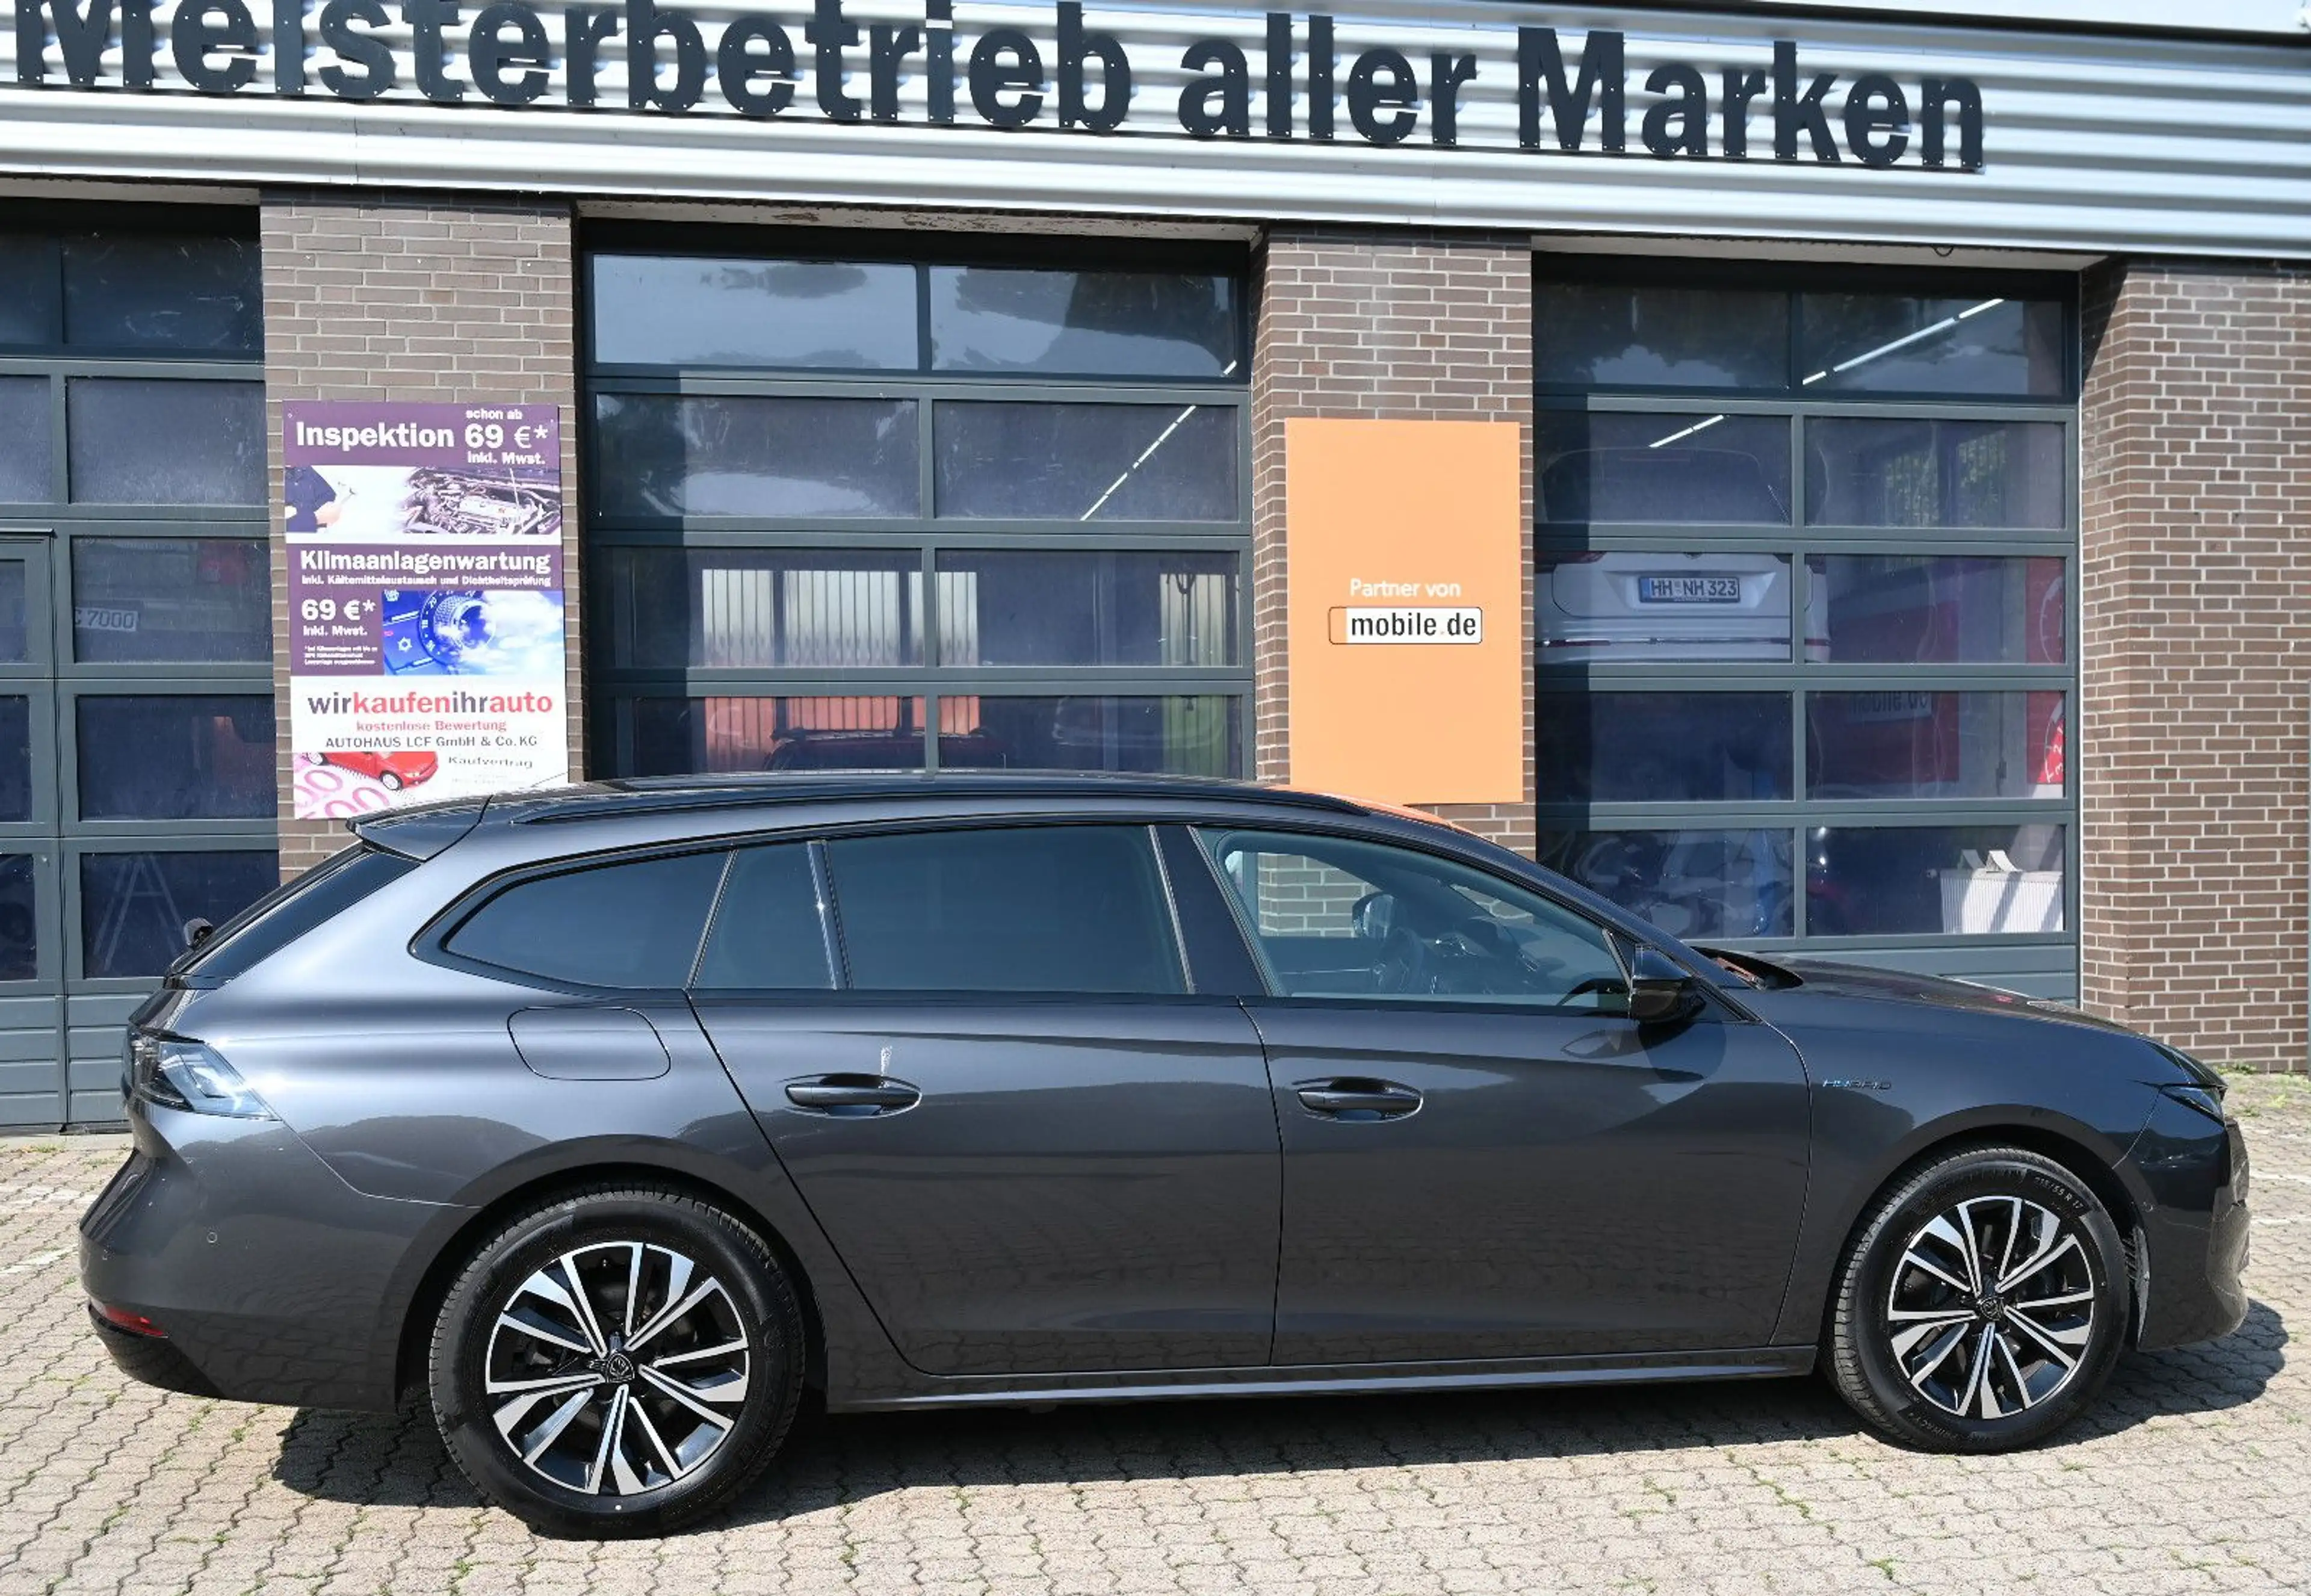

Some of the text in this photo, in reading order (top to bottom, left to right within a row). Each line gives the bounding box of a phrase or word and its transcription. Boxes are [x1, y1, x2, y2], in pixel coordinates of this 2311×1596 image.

[16, 0, 1984, 169] Meisterbetrieb aller Marken
[466, 409, 523, 419] schon ab
[297, 422, 454, 451] Inspektion
[465, 423, 504, 448] 69
[501, 452, 546, 465] Mwst.
[301, 551, 551, 574] Klimaanlagenwartung
[441, 576, 459, 585] und
[1350, 578, 1461, 598] Partner von
[1651, 580, 1737, 596] HH NH 323
[302, 599, 336, 620] 69
[88, 610, 134, 629] 7000
[1351, 611, 1476, 637] mobile.de
[308, 691, 553, 714] wirkaufenihrauto
[356, 720, 507, 733] kostenlose Bewertung
[326, 735, 537, 748] AUTOHAUS LCF GmbH & Co. KG
[449, 756, 533, 770] Kaufvertrag
